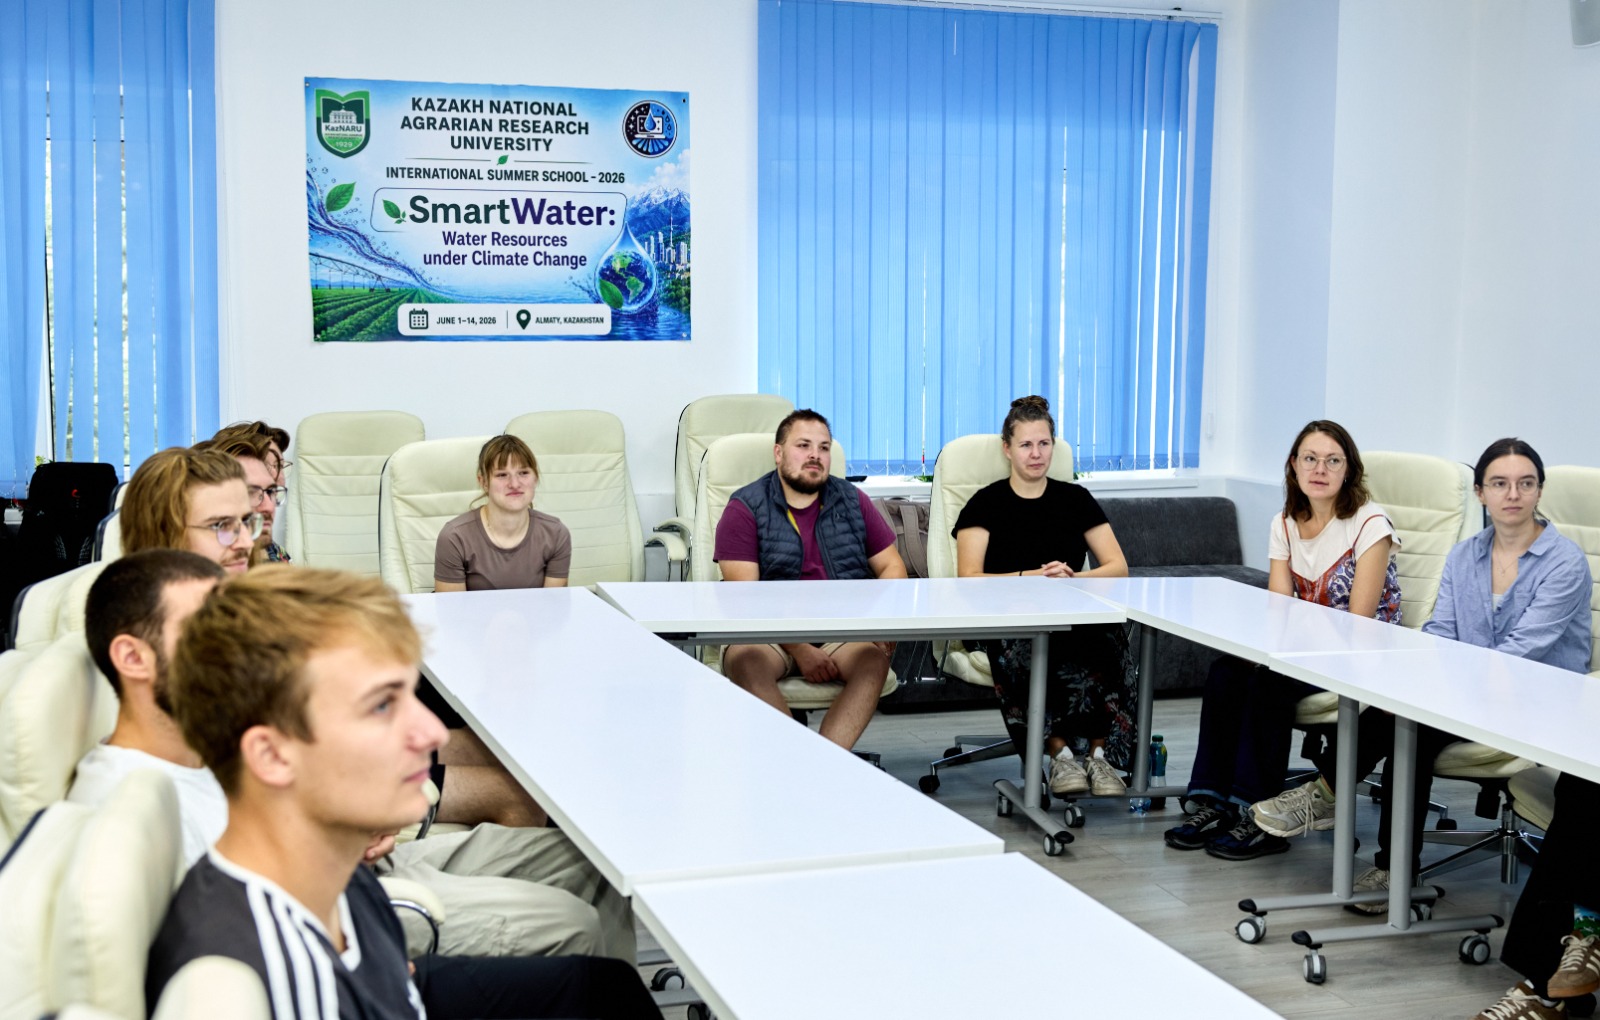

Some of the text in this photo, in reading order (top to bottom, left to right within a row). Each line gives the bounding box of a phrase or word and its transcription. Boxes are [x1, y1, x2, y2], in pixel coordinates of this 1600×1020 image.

[411, 97, 577, 116] KAZAKH NATIONAL
[325, 124, 362, 132] KazNARU
[400, 116, 589, 135] AGRARIAN RESEARCH
[450, 136, 553, 151] UNIVERSITY
[386, 166, 484, 180] INTERNATIONAL
[487, 169, 539, 182] SUMMER
[542, 170, 589, 183] SCHOOL
[598, 172, 625, 184] 2026
[409, 195, 616, 226] SmartWater:
[442, 231, 568, 248] Water Resources
[423, 251, 587, 269] under Climate Change
[436, 316, 456, 325] JUNE
[479, 316, 497, 325] 2026
[535, 316, 604, 325] ALMATY, KAZAKHSTAN
